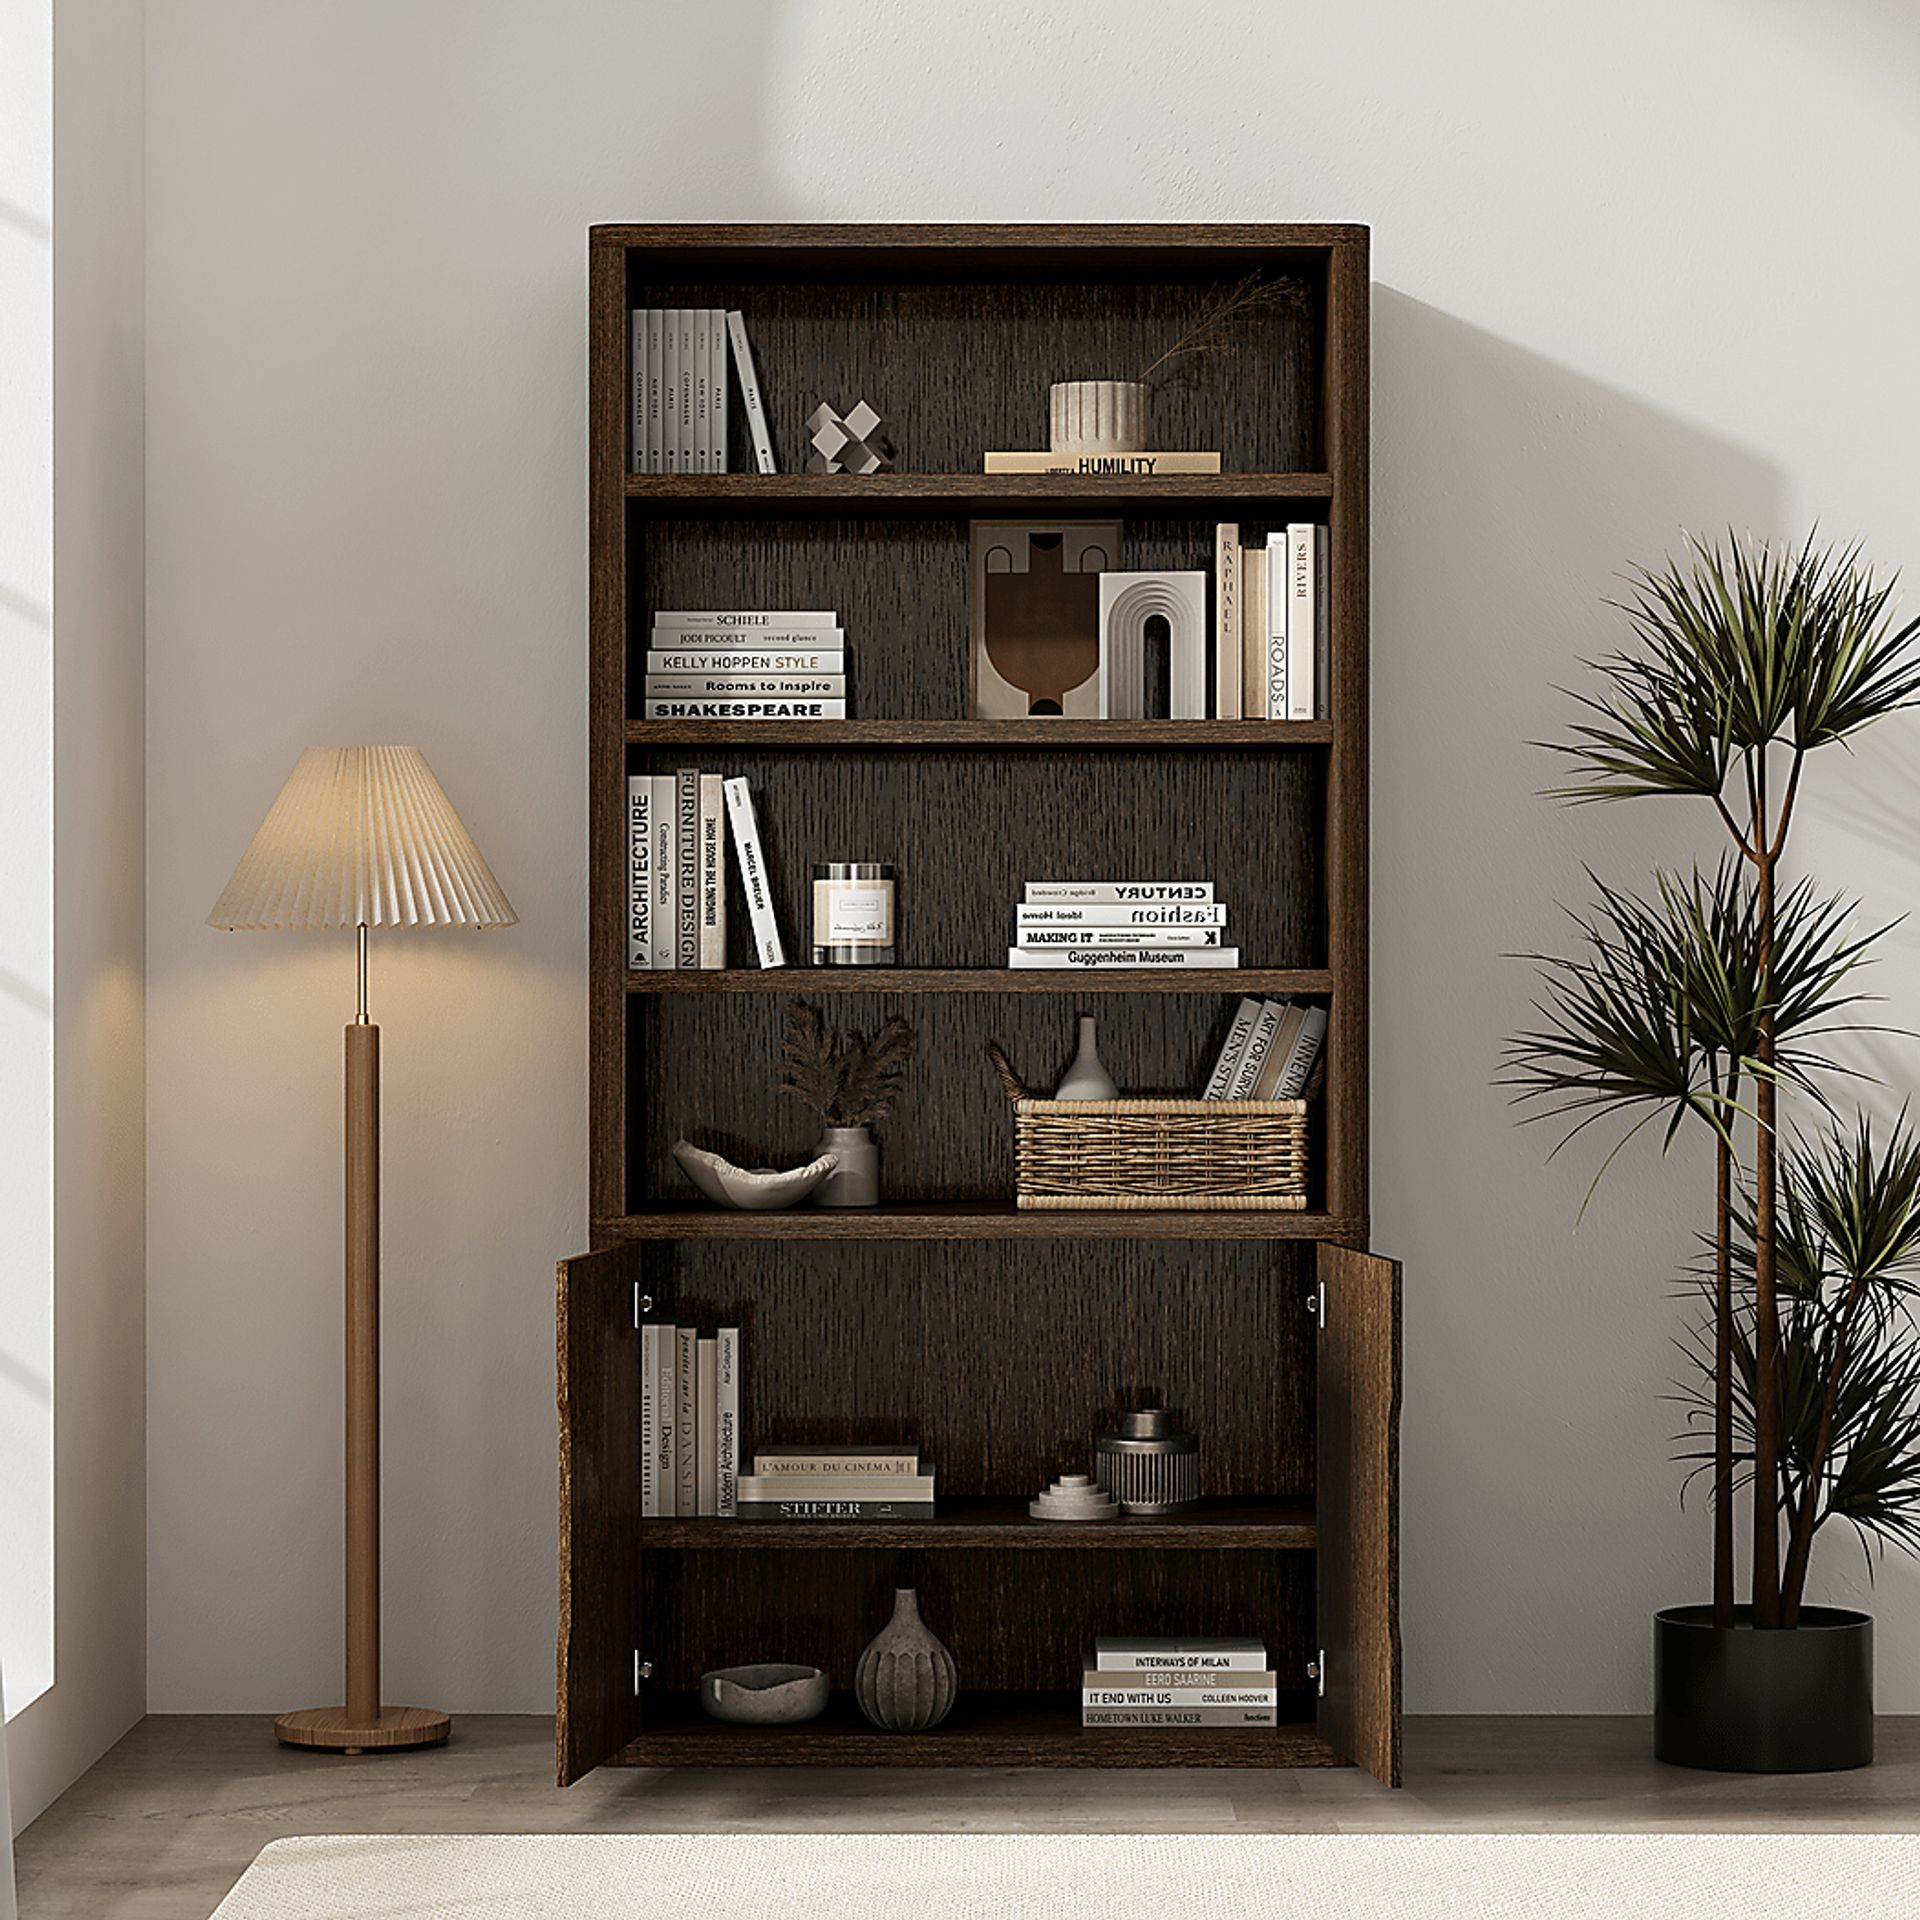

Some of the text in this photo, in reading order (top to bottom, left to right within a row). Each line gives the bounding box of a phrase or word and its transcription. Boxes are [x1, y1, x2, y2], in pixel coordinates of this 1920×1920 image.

[748, 388, 757, 410] PARIS
[1078, 458, 1157, 475] HUMILITY
[1296, 543, 1308, 598] RIVERS
[1223, 541, 1233, 633] RAPHAEL
[716, 615, 770, 626] SCHIELE
[680, 634, 747, 644] JODI PICOULT
[763, 634, 817, 644] second glance
[663, 656, 819, 669] KELLY HOPPEN STYLE
[1271, 636, 1285, 704] ROADS
[705, 681, 756, 692] Rooms
[760, 682, 776, 692] to
[780, 681, 832, 694] Inspire
[655, 704, 823, 717] SHAKESPEARE
[632, 795, 649, 944] ARCHITECTURE
[681, 771, 696, 967] FURNITURE DESIGN
[705, 817, 717, 926] BRINGING THE HOUSE HOME
[744, 842, 765, 910] MARCEL BREUER
[1026, 933, 1077, 943] MAKING
[1080, 933, 1093, 943] IT
[1068, 951, 1185, 966] Guggenheim Museum
[1260, 1011, 1278, 1036] ART
[1223, 1018, 1252, 1064] MEN'S
[1248, 1036, 1268, 1062] FOR
[658, 1367, 672, 1470] Editorial Design
[682, 1422, 692, 1496] DANSE
[720, 1411, 733, 1510] Modern Architecture
[762, 1463, 818, 1472] L'AMOUR
[822, 1463, 841, 1472] DU
[780, 1502, 861, 1514] STIFTER
[1135, 1658, 1231, 1668] INTERWAYS OF MILAN
[1145, 1673, 1217, 1686] EERO SAARINE
[1089, 1693, 1172, 1704] IT END WITH US
[1202, 1694, 1269, 1703] COLLEEN HOOVER
[1086, 1713, 1202, 1724] HOMETOWN LUKE WALKER
